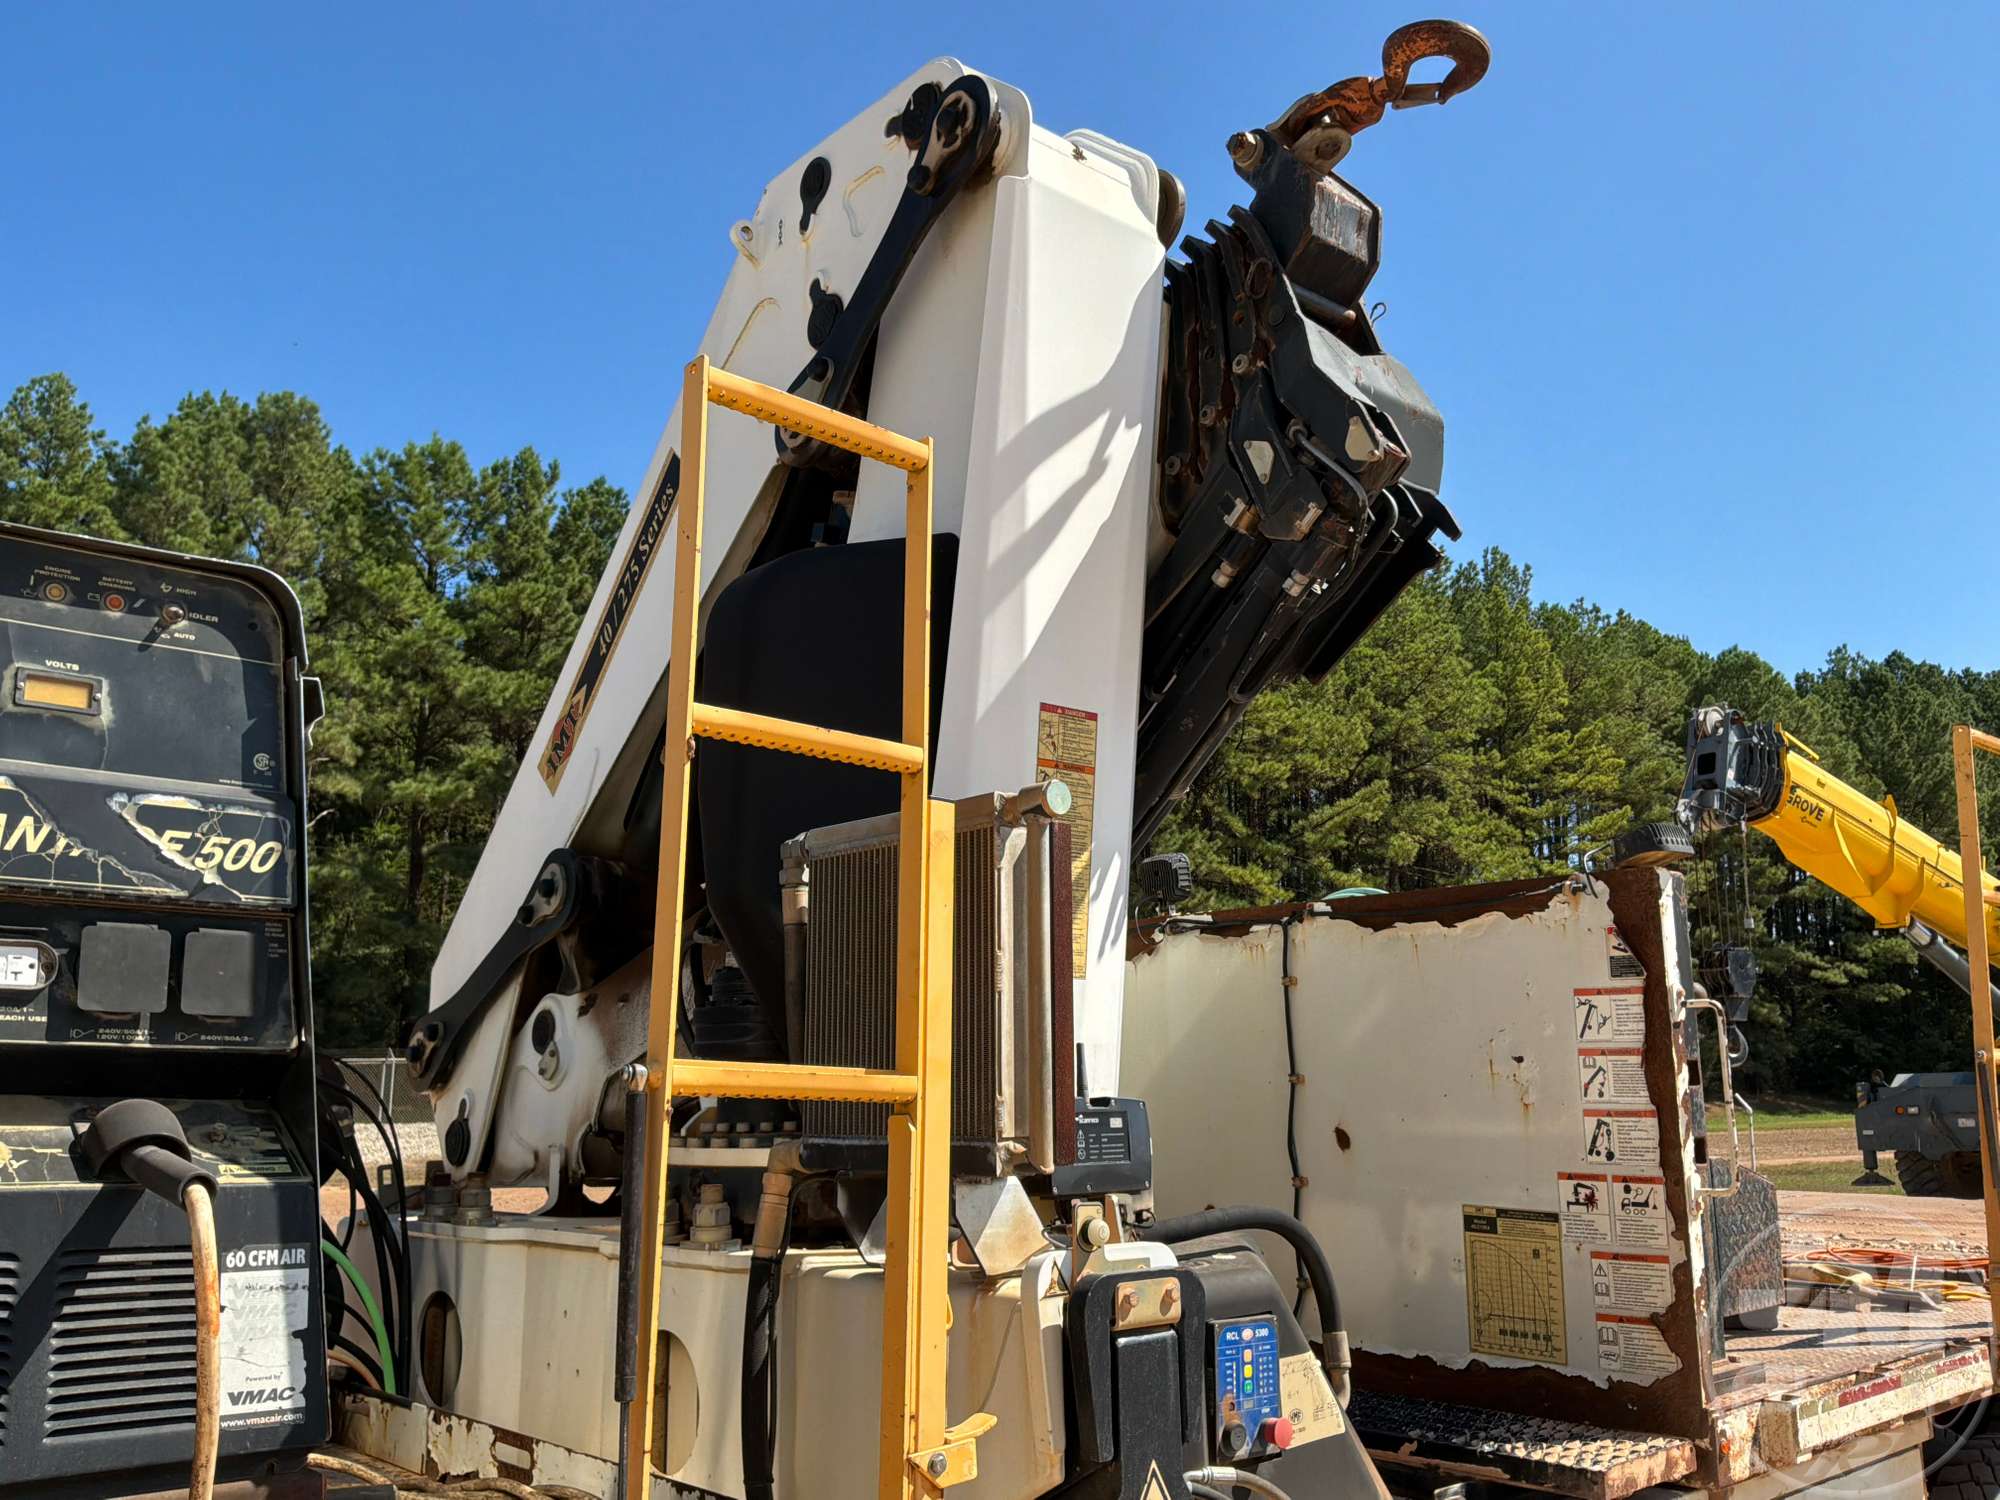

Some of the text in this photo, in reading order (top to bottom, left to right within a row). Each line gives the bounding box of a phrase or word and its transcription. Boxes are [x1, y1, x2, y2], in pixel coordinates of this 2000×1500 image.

[34, 569, 81, 582] PROTECTION
[44, 565, 72, 575] ENGINE
[600, 623, 613, 657] 40
[618, 559, 640, 610] 275
[639, 482, 674, 561] Series
[98, 582, 136, 592] CHARGING
[102, 576, 134, 586] BATTERY
[189, 612, 219, 623] IDLER
[173, 632, 196, 641] AUTO
[45, 659, 80, 671] VOLTS
[545, 702, 579, 777] IMT
[194, 836, 282, 874] 500
[226, 1248, 306, 1269] 60 CFM AIR
[1226, 1331, 1240, 1341] RCL
[227, 1386, 296, 1406] VMAC
[220, 1412, 304, 1428] www.vmacair.com
